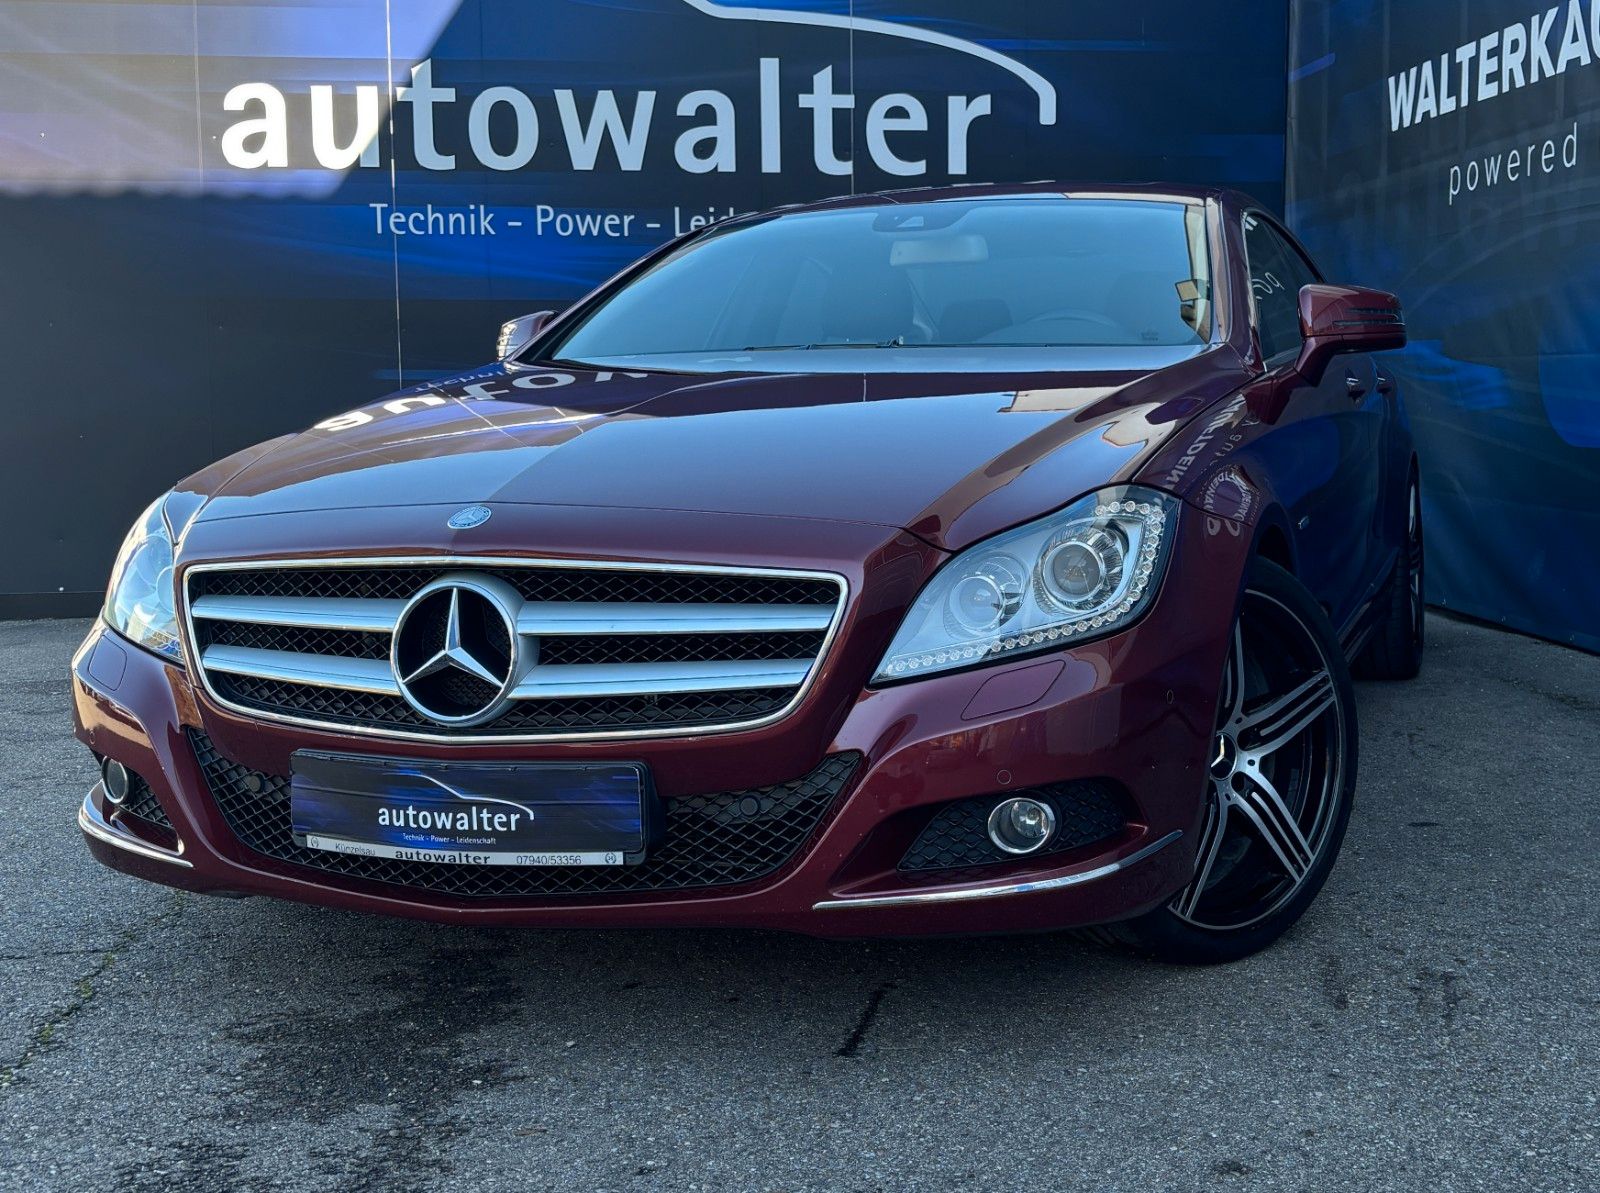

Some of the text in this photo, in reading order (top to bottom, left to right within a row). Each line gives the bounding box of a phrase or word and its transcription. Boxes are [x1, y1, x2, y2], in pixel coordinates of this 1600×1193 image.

[221, 57, 992, 176] autowalter
[1449, 122, 1578, 206] powered
[369, 203, 496, 236] Technik
[536, 205, 635, 237] Power
[377, 806, 521, 831] autowalter
[395, 849, 491, 865] autowalter
[516, 855, 582, 866] 07940/53356
